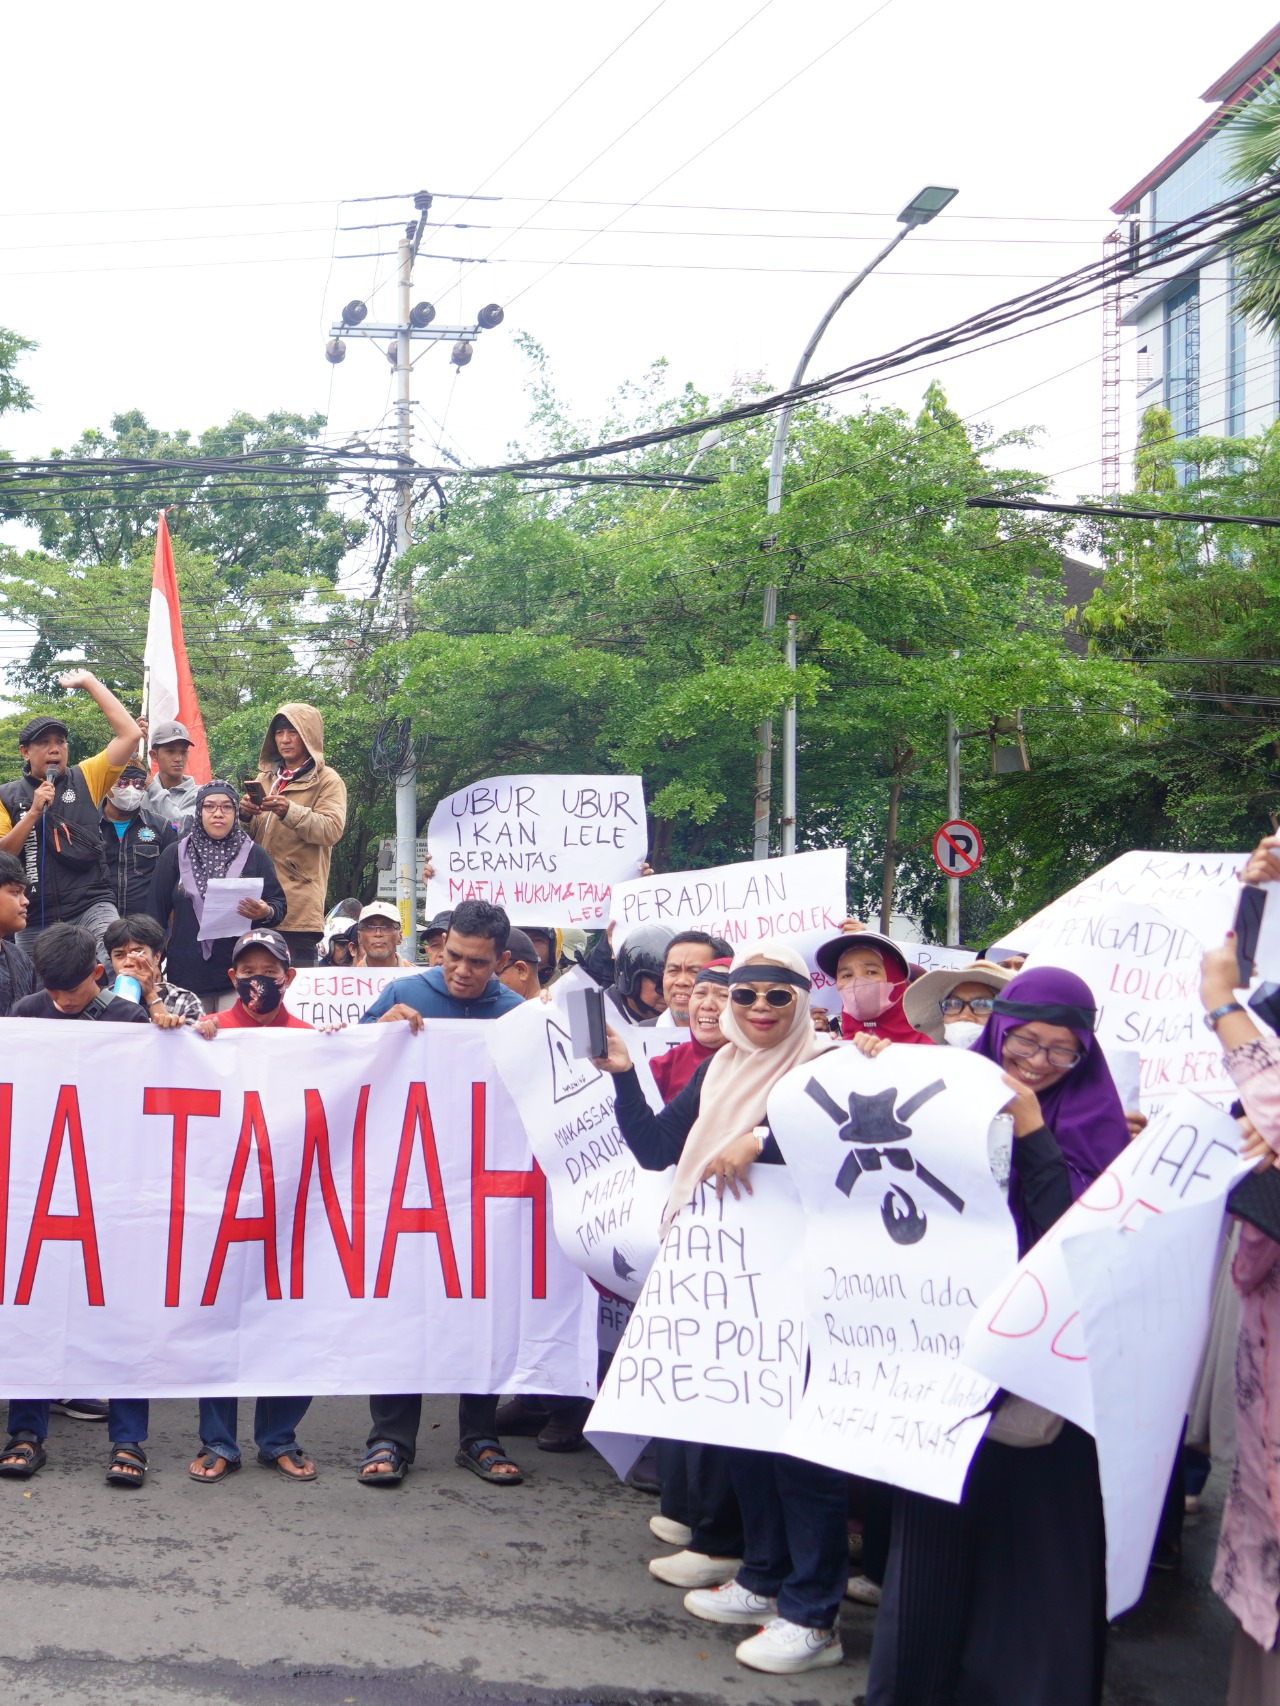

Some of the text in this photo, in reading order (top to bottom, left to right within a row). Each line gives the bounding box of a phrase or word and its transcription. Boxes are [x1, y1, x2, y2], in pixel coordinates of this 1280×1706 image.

[451, 786, 638, 825] UBUR UBUR
[457, 821, 626, 848] IKAN LELE
[450, 852, 557, 873] BERANTAS
[449, 878, 506, 904] MAFIA
[623, 872, 786, 923] PERADILAN
[569, 906, 603, 922] LEE
[756, 906, 841, 940] DICOLEK
[1116, 1011, 1193, 1045] SIAGA
[565, 1126, 630, 1185] DARUR
[142, 1081, 547, 1306] TANAH
[581, 1166, 636, 1213] MAFIA
[576, 1197, 634, 1257] TANAH
[823, 1266, 978, 1307] Jangan ada
[716, 1320, 803, 1373] POLRI
[618, 1356, 792, 1420] PRESISI
